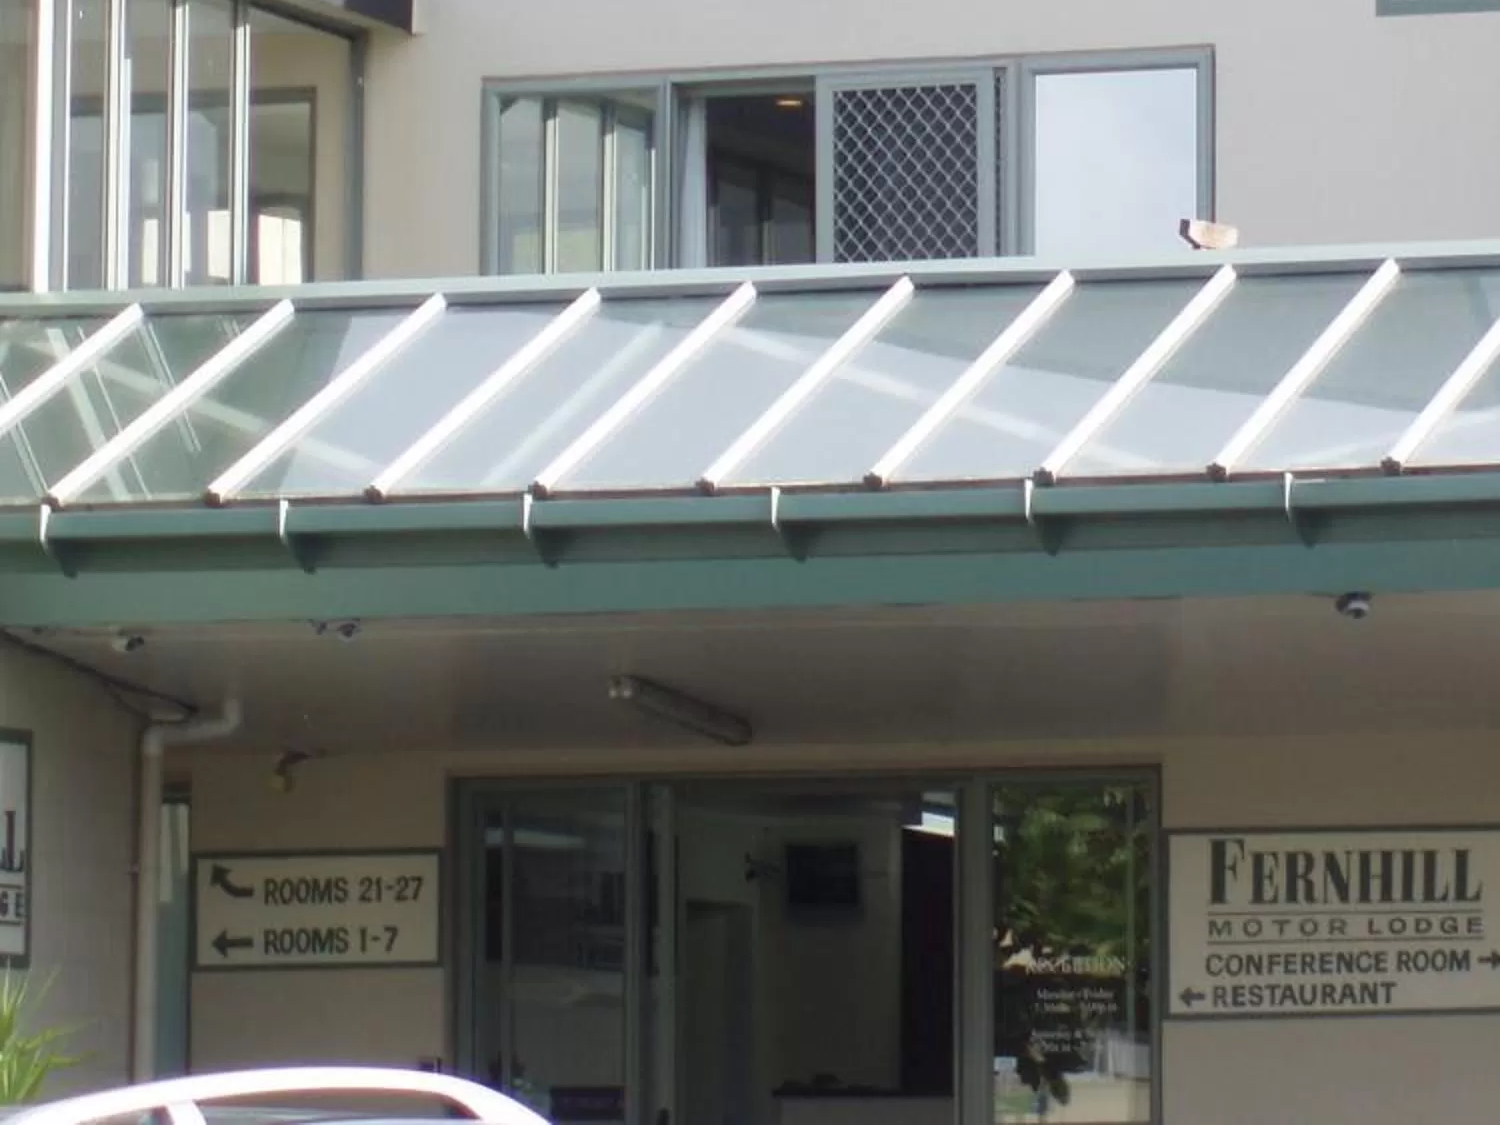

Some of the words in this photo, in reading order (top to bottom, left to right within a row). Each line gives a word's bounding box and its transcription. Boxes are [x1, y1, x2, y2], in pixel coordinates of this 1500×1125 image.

[1207, 837, 1482, 906] FERNHILL
[264, 876, 349, 904] ROOMS
[358, 876, 424, 903] 21-27
[1208, 918, 1347, 938] MOTOR
[1367, 916, 1484, 935] LODGE
[263, 927, 349, 956] ROOMS
[359, 926, 399, 952] 1-7
[1205, 951, 1388, 976] CONFERENCE
[1396, 949, 1471, 973] ROOM
[1212, 981, 1398, 1007] RESTAURANT
